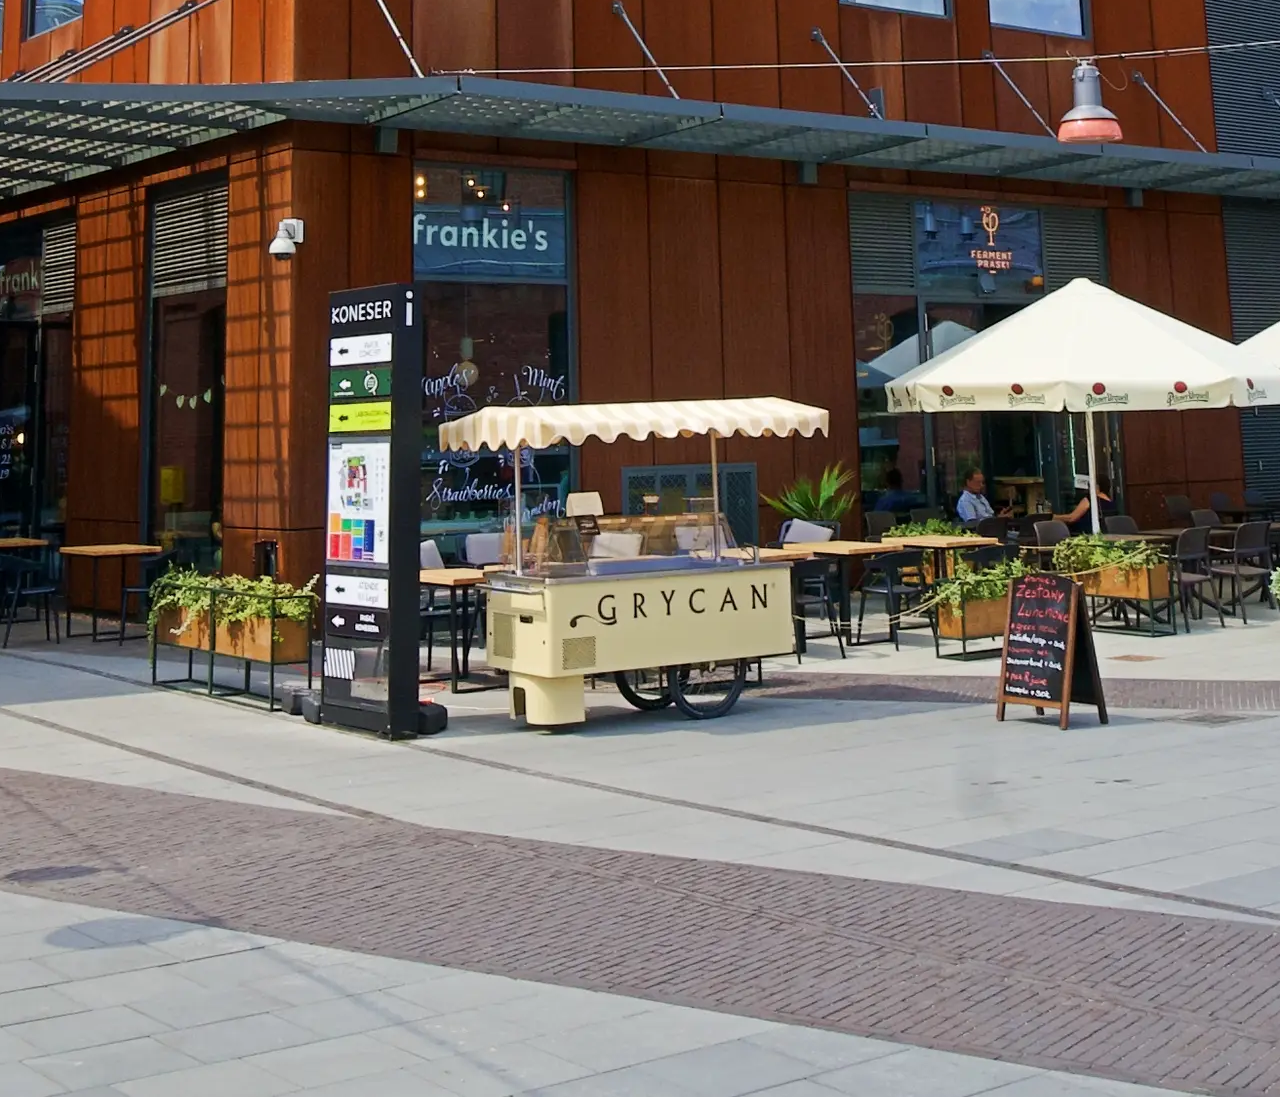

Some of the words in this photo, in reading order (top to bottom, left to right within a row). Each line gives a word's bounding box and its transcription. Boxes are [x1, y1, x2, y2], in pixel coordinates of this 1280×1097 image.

[413, 213, 549, 251] frankie's
[971, 250, 1013, 260] FERMENT
[977, 259, 1010, 269] PRASKI
[331, 300, 392, 324] KONESER
[522, 365, 565, 401] Mint
[426, 477, 515, 510] Strawberries
[596, 584, 768, 624] GRYCAN
[1016, 583, 1066, 604] Zestawy
